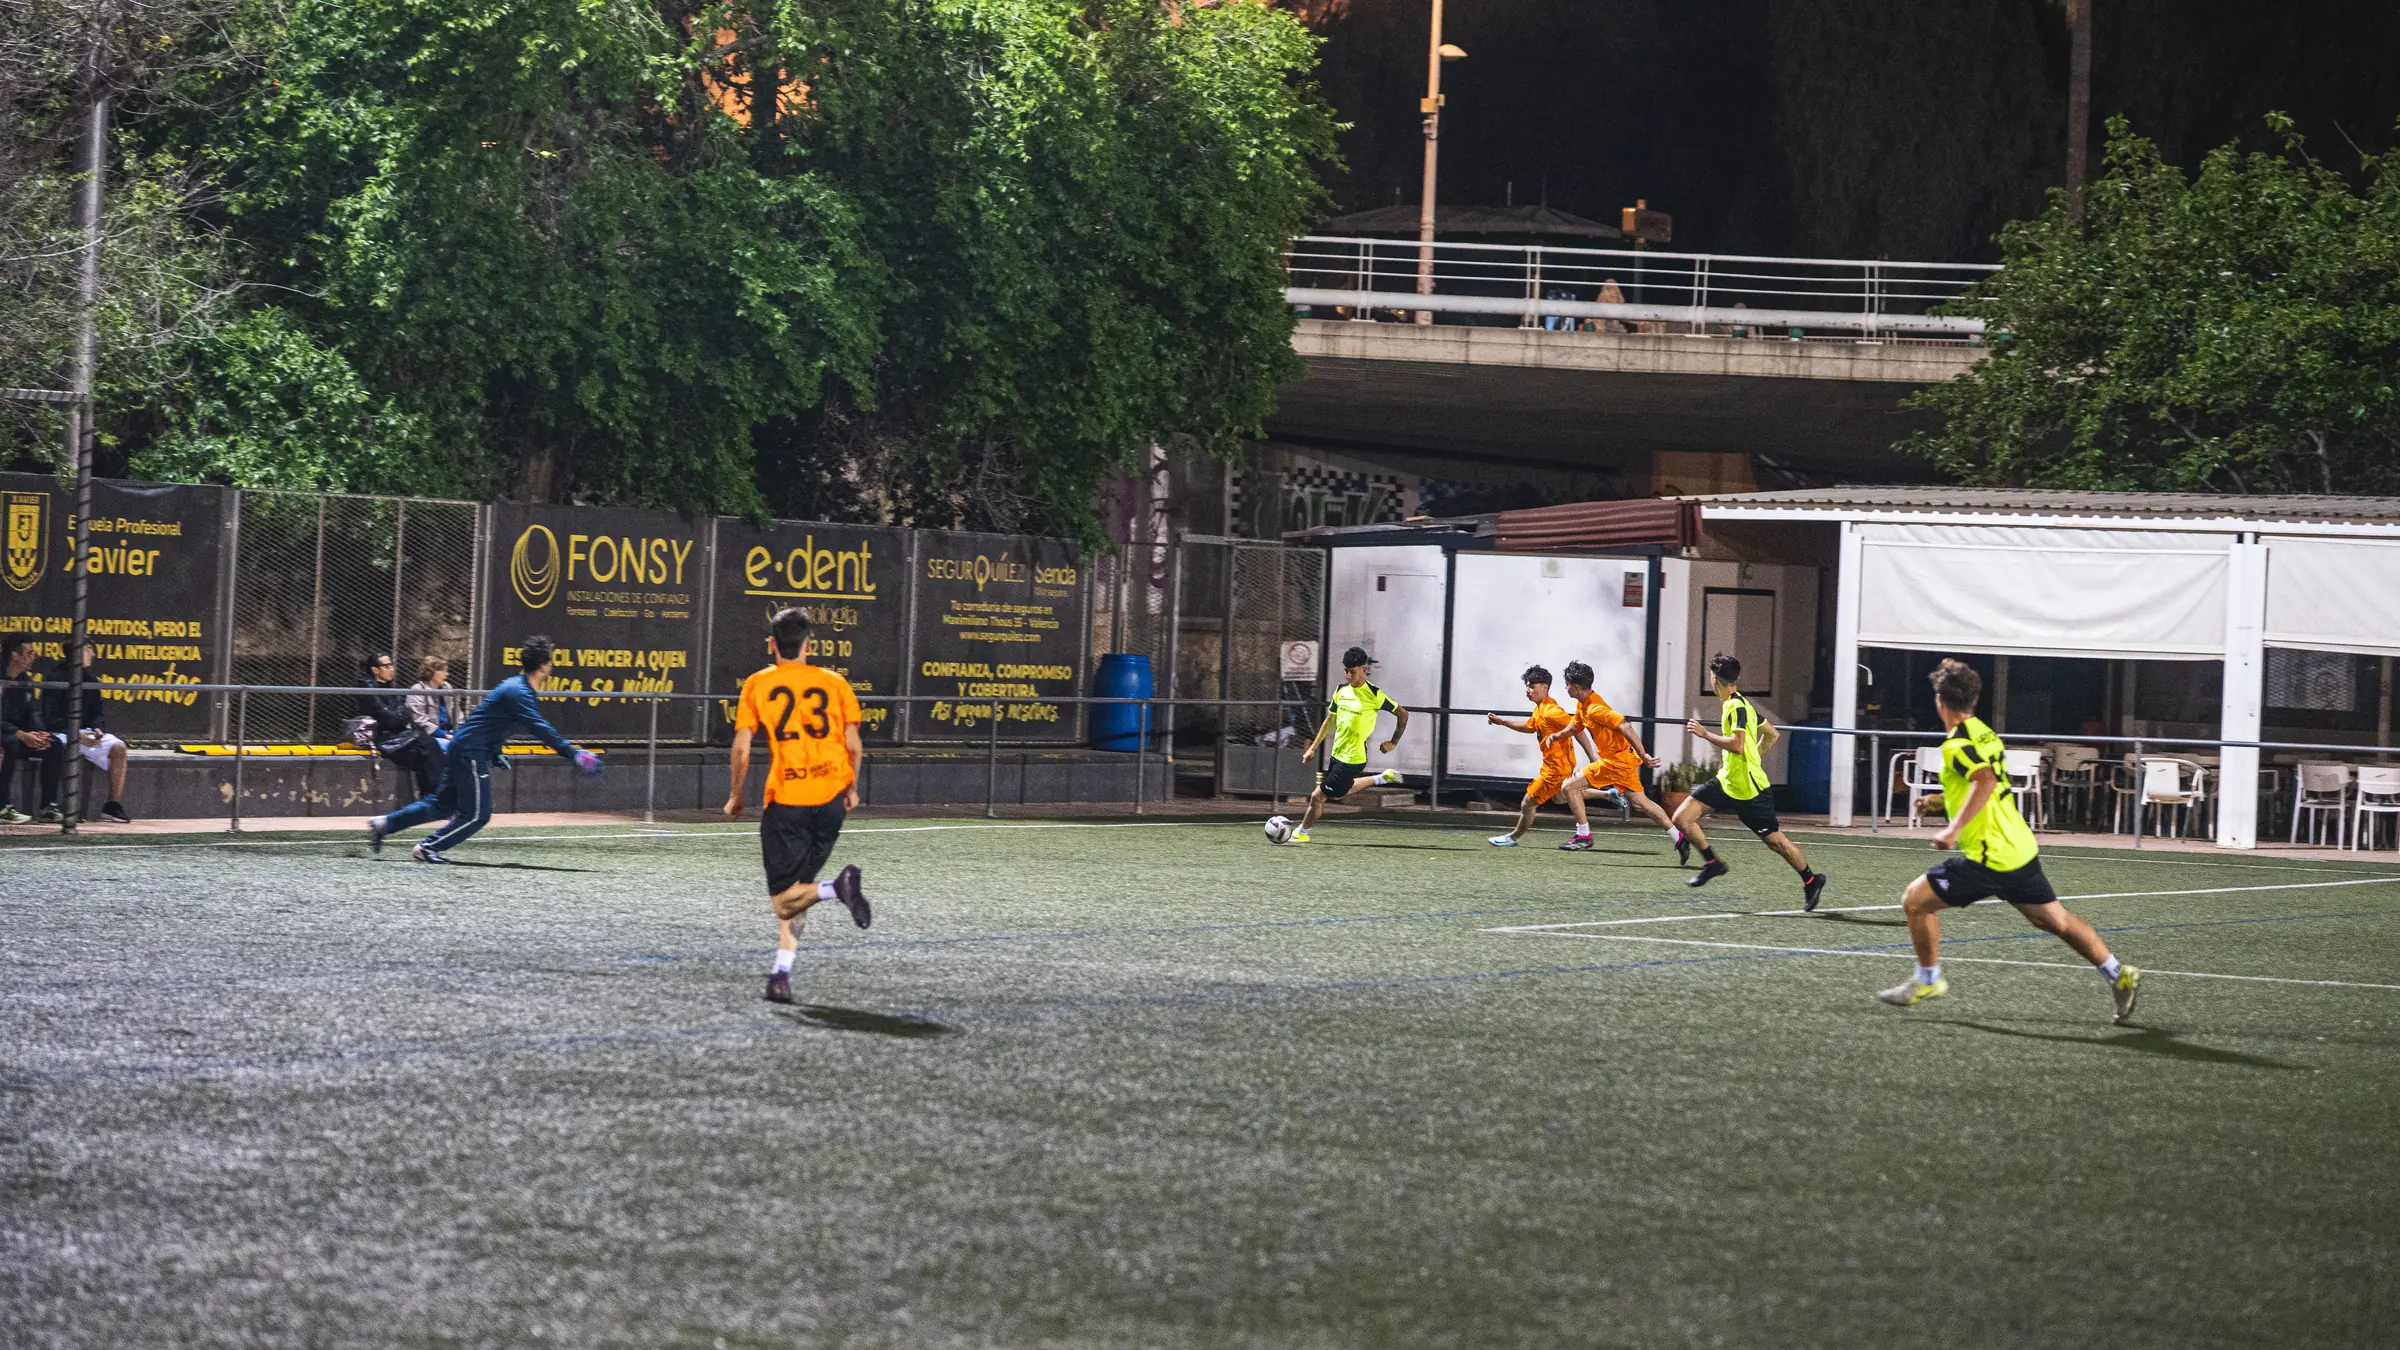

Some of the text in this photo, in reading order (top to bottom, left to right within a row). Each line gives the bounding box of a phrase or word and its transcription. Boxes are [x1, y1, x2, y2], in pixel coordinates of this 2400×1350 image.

[67, 514, 182, 536] Euela Profesional
[568, 534, 694, 585] FONSY
[1034, 561, 1077, 586] Senda
[45, 617, 73, 634] GAN
[86, 618, 152, 640] PARTIDOS,
[153, 621, 187, 638] PERO
[188, 621, 202, 638] EL
[95, 643, 106, 660] Y
[107, 643, 123, 660] LA
[125, 644, 202, 662] INTELIGENCIA
[576, 648, 632, 668] VENCER
[634, 650, 646, 668] A
[648, 650, 687, 672] QUIEN
[837, 640, 853, 658] 10
[922, 661, 1073, 681] CONFIANZA, COMPROMISO
[957, 681, 1040, 698] Y COBERTURA.
[768, 685, 830, 742] 23
